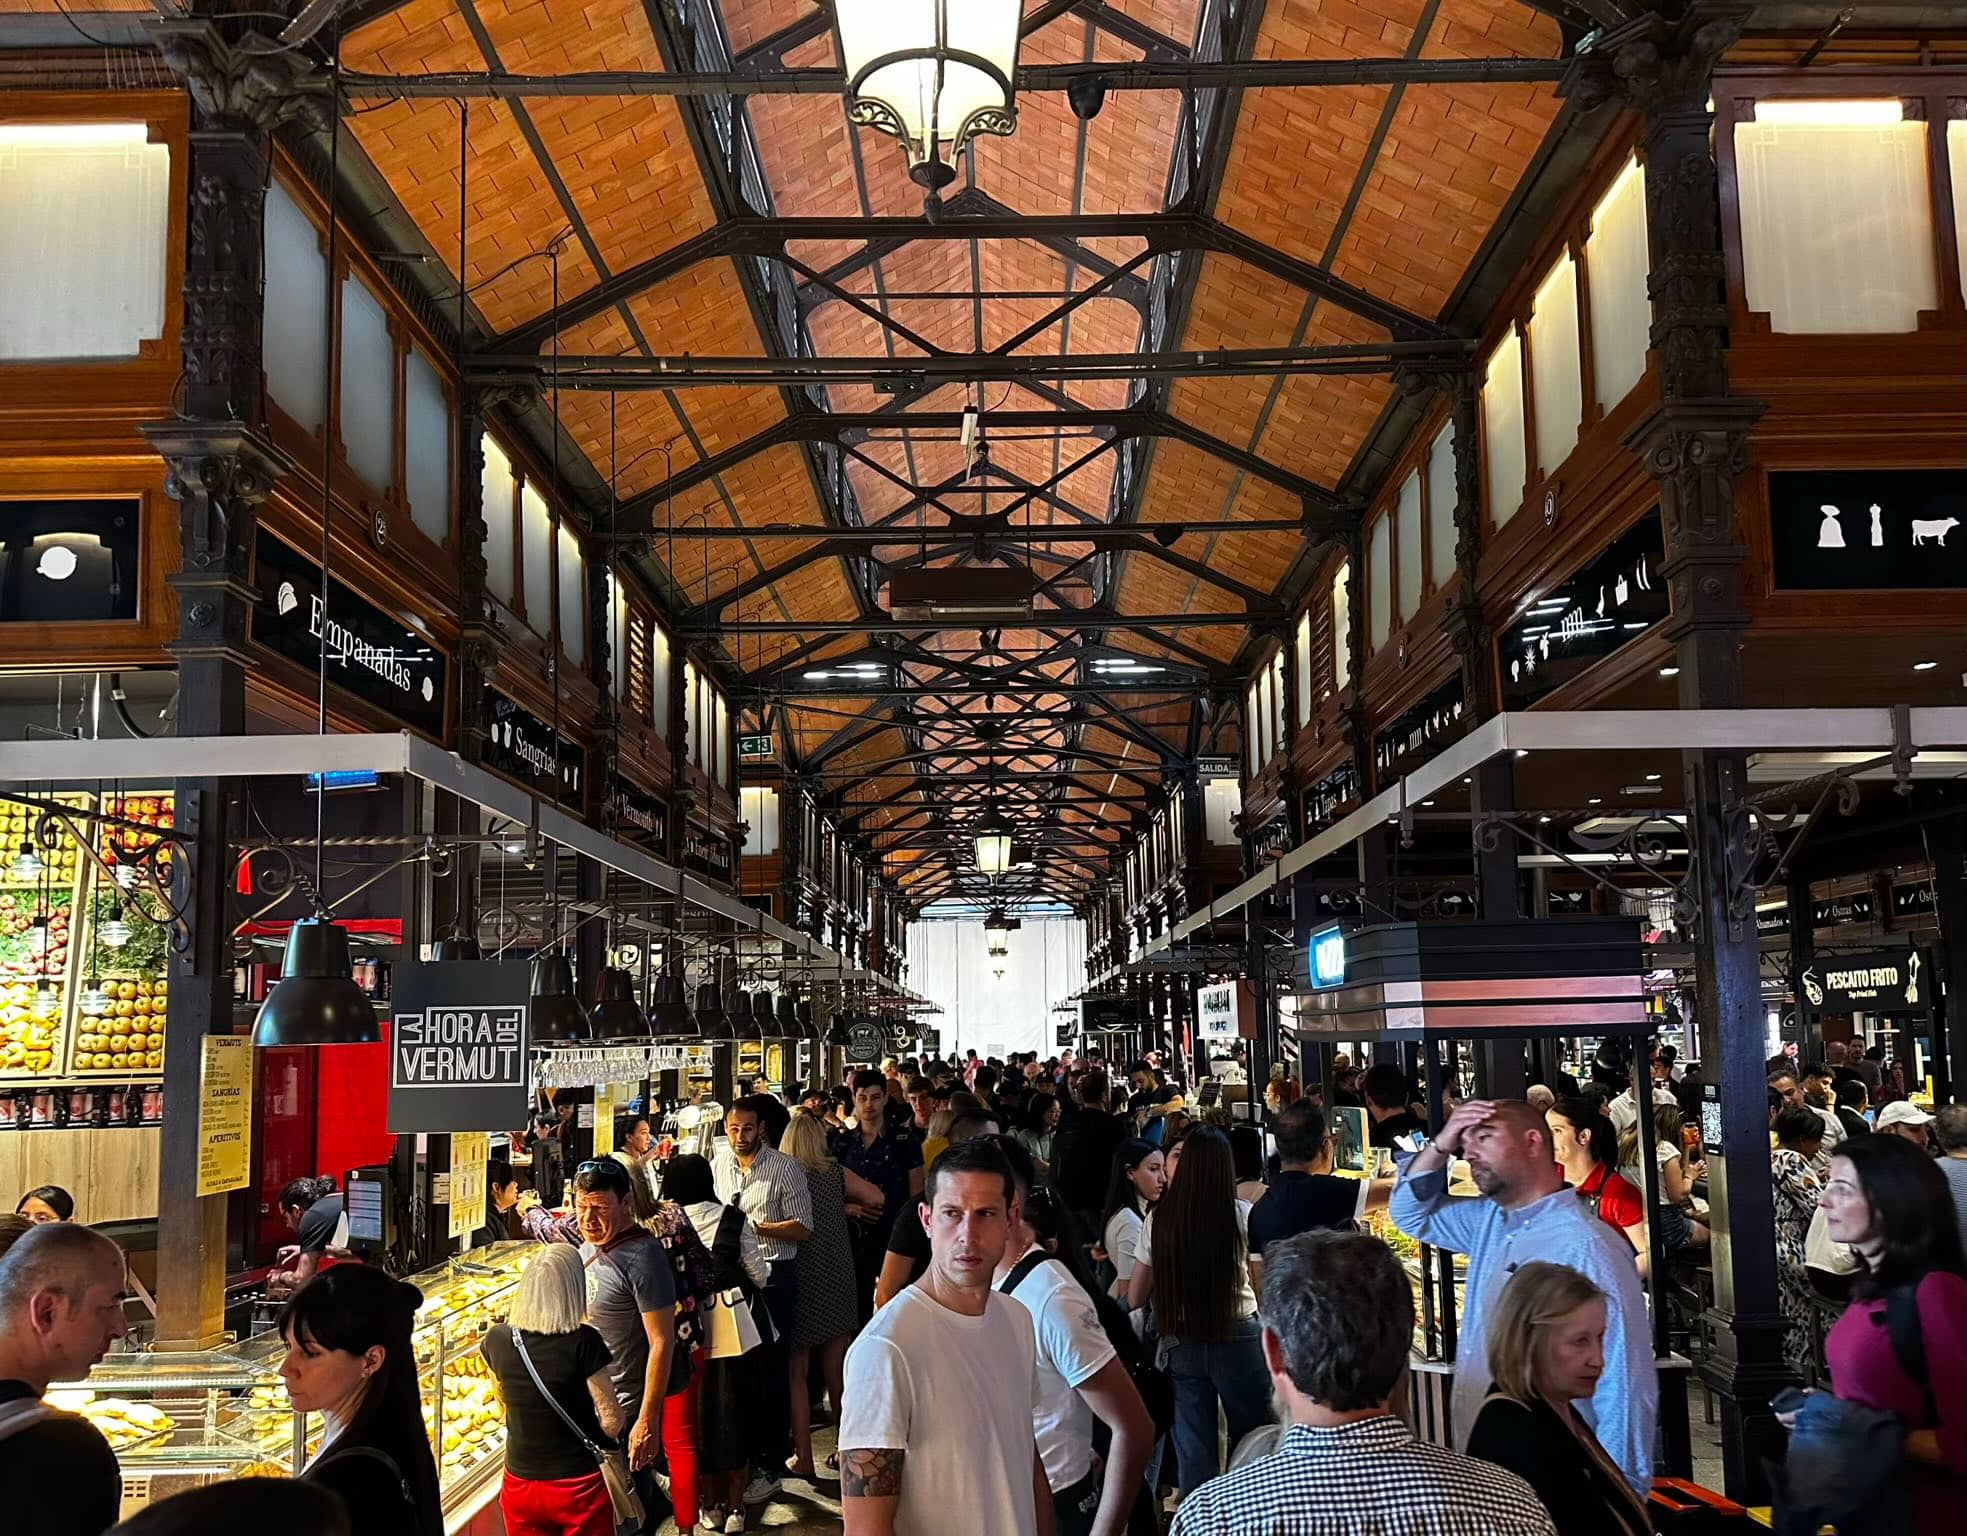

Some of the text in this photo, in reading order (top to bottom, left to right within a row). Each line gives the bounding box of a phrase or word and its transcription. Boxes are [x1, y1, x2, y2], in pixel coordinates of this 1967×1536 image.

[308, 593, 411, 692] Empanadas
[515, 726, 556, 776] Sangrías
[1199, 763, 1229, 773] SALIDA
[1826, 966, 1898, 990] PESCAITO FRITO
[401, 1012, 518, 1044] LA HORA DEL
[401, 1046, 518, 1081] VERMUT
